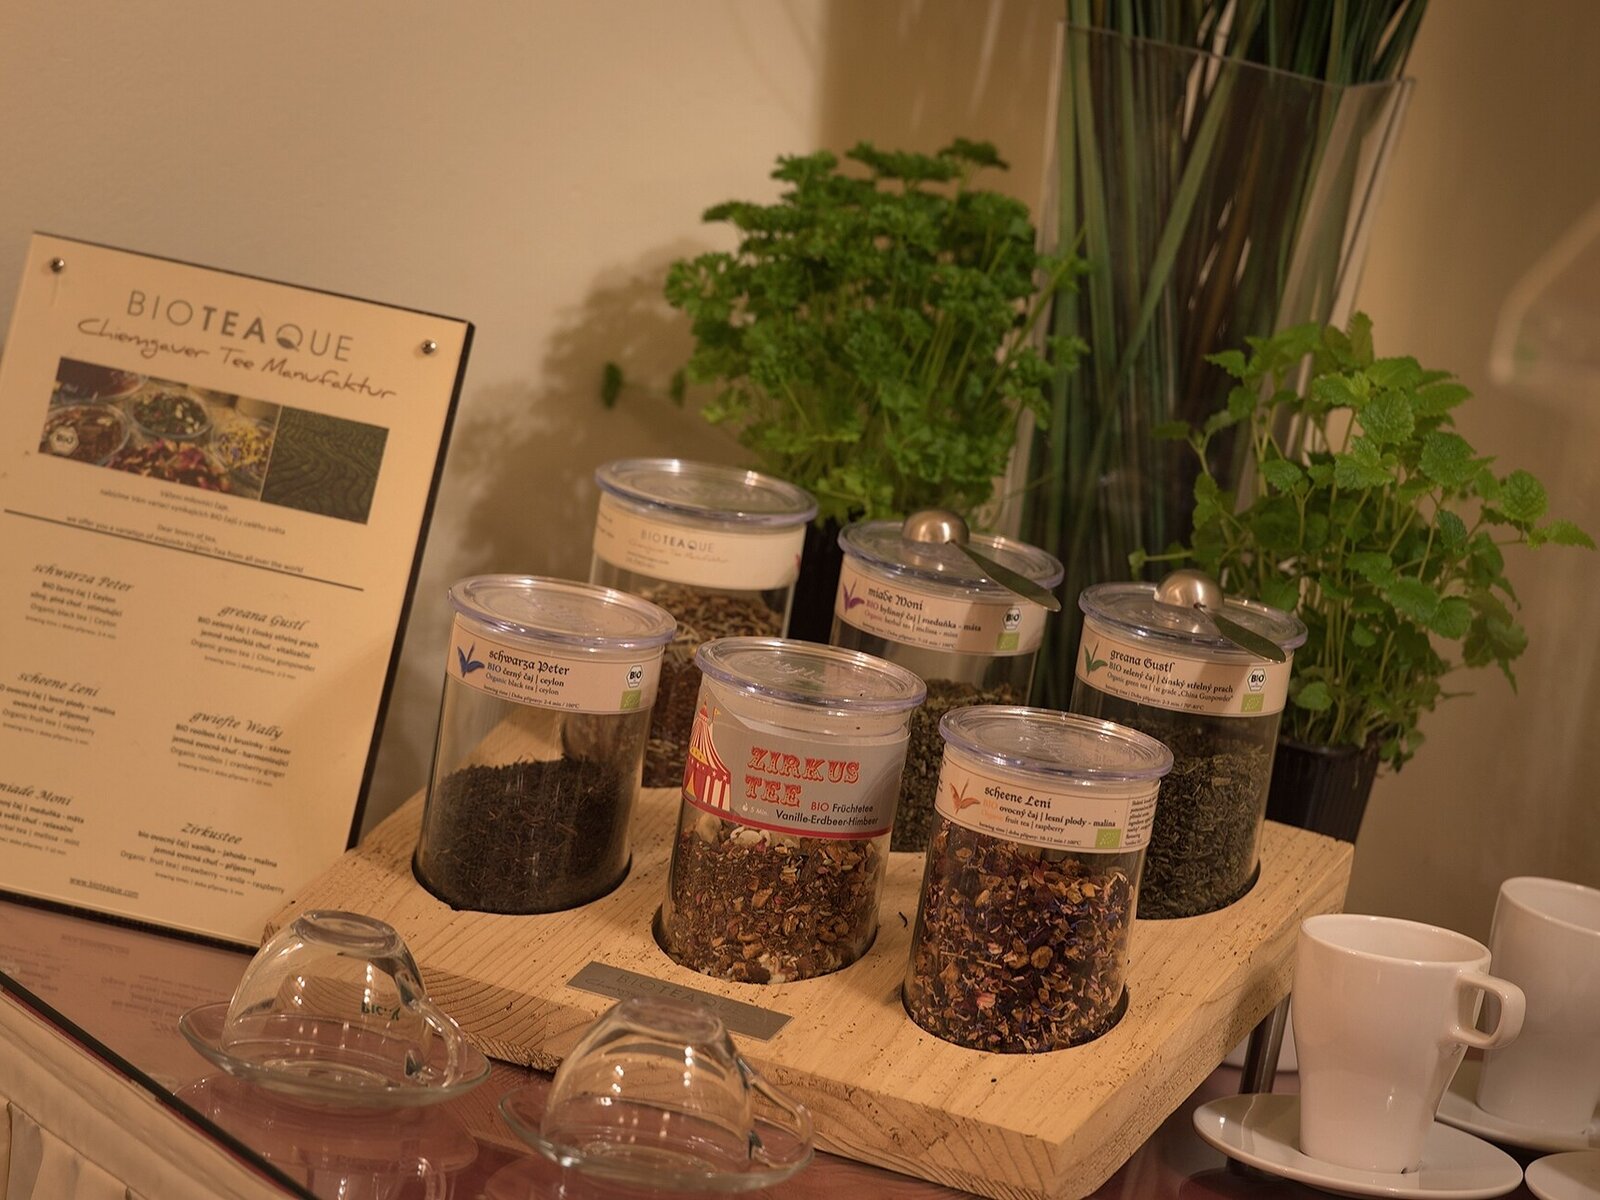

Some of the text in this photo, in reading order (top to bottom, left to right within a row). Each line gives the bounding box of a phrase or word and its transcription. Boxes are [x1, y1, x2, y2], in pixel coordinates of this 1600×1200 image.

[127, 289, 353, 362] BIOTEAQUE
[220, 346, 255, 370] Tee
[260, 357, 396, 399] Manufaktur
[157, 524, 173, 533] Dear
[174, 528, 195, 538] lovers
[641, 529, 716, 553] BIOTEAQUE
[78, 518, 94, 527] offer
[95, 523, 109, 531] you
[115, 528, 145, 539] variation
[154, 536, 184, 547] exquisite
[227, 550, 244, 559] from
[271, 560, 283, 569] the
[33, 563, 134, 592] schwarza Peter
[57, 609, 75, 618] black
[76, 613, 87, 621] tea
[218, 606, 310, 631] greana Gustl
[866, 600, 879, 610] BIO
[879, 604, 905, 620] bylinný
[1006, 612, 1020, 623] BIO
[217, 646, 237, 654] green
[239, 650, 250, 658] tea
[488, 650, 570, 676] schwarza Peter
[1110, 649, 1141, 666] greana
[17, 672, 99, 697] scheene Leni
[485, 672, 507, 683] Organic
[508, 679, 523, 689] black
[539, 686, 559, 696] ceylon
[488, 662, 565, 688] BIO černý čaj ceylon
[629, 671, 642, 680] BIO
[1108, 662, 1122, 673] BIO
[1123, 668, 1145, 679] zelený
[1145, 673, 1156, 684] čaj
[1213, 684, 1233, 694] prach
[1125, 679, 1140, 689] green
[1250, 674, 1265, 684] BIO
[246, 720, 284, 742] Wally
[747, 745, 860, 784] ZIRKUS
[744, 774, 801, 809] TEE
[983, 785, 1051, 809] scheene Leni
[776, 808, 879, 827] Vanille-Erdbeer-Himbeer
[810, 801, 874, 814] BIO Früchtetee
[998, 805, 1027, 818] ovocný
[1027, 809, 1039, 821] čaj
[1044, 813, 1064, 826] lesní
[1064, 818, 1088, 829] plody
[1093, 819, 1116, 828] malina
[181, 822, 243, 844] Zirkustee
[1005, 816, 1020, 828] fruit
[1020, 820, 1030, 828] tea
[1034, 823, 1065, 835] raspberry
[120, 850, 146, 862] Organic
[149, 857, 164, 866] fruit
[181, 865, 218, 879] strawberry
[252, 881, 285, 895] raspberry
